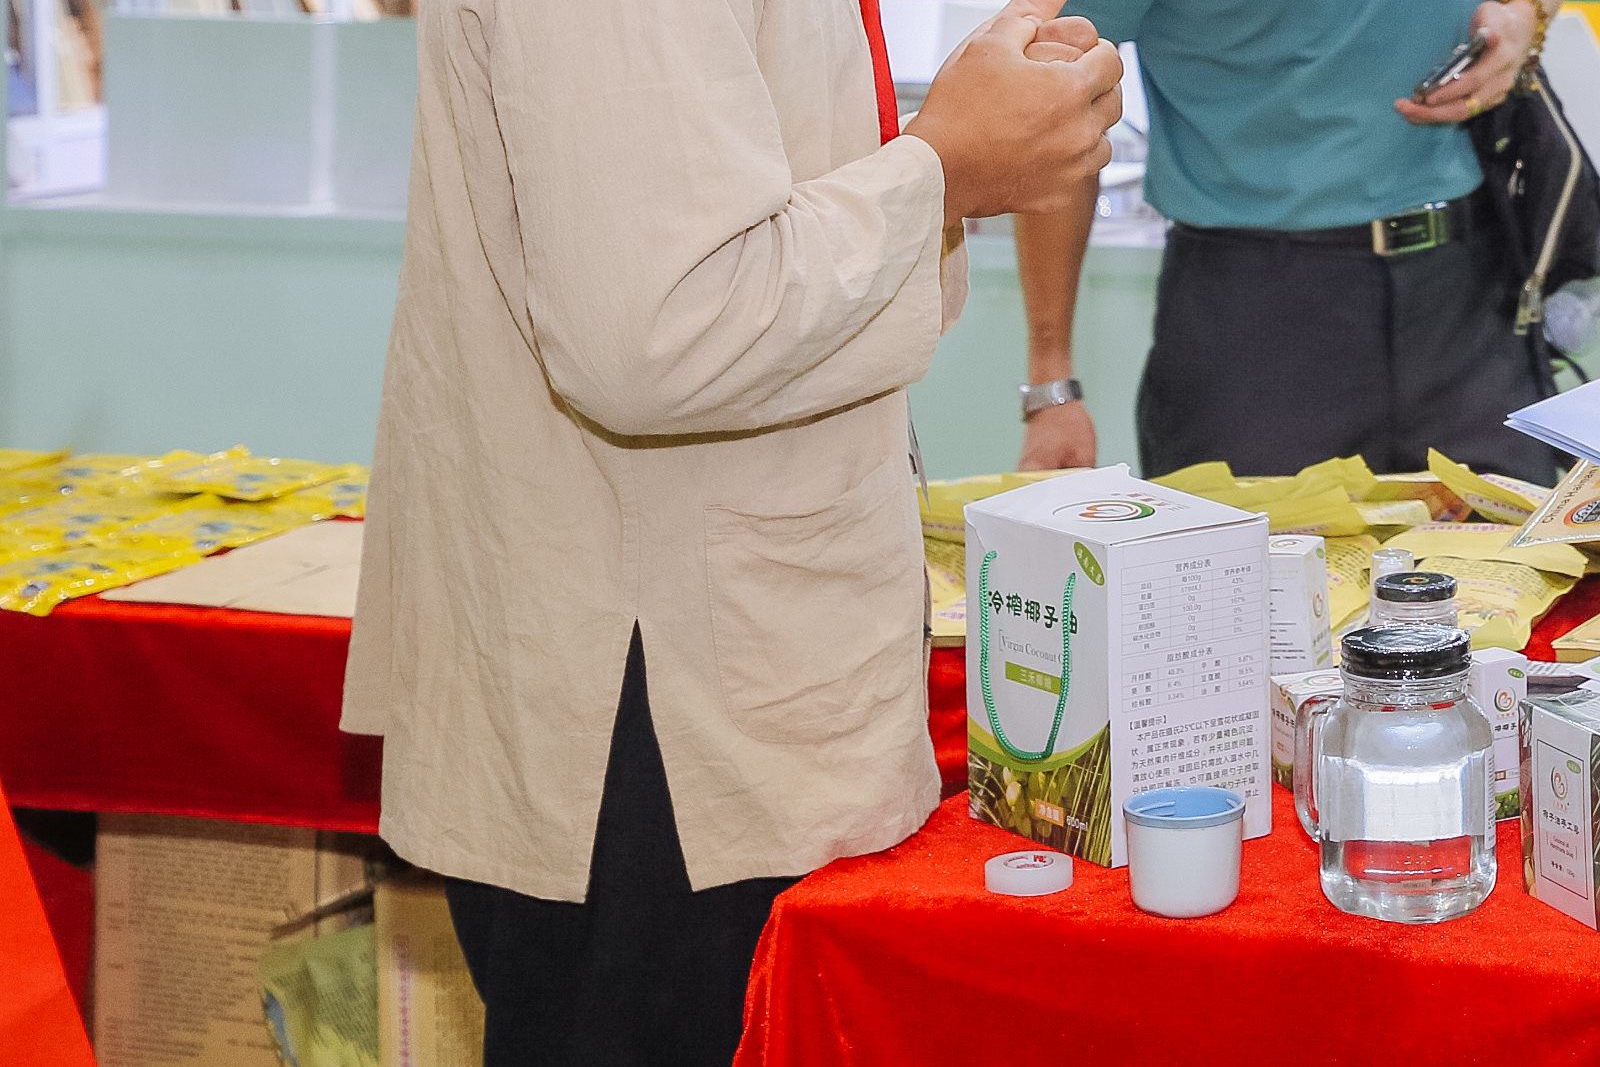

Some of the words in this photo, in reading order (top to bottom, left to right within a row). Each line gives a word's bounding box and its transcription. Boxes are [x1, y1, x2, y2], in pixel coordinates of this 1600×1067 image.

[1542, 498, 1571, 524] China
[1175, 558, 1212, 573] 营养成分表
[1187, 595, 1196, 603] 0g
[1187, 614, 1196, 622] 0g
[1187, 624, 1196, 632] 0g
[1233, 616, 1242, 624] 0%
[1185, 634, 1198, 642] 0mg
[1001, 635, 1024, 654] Virgin
[1025, 642, 1057, 663] Coconut
[1166, 647, 1213, 663] 脂肪酸成分表
